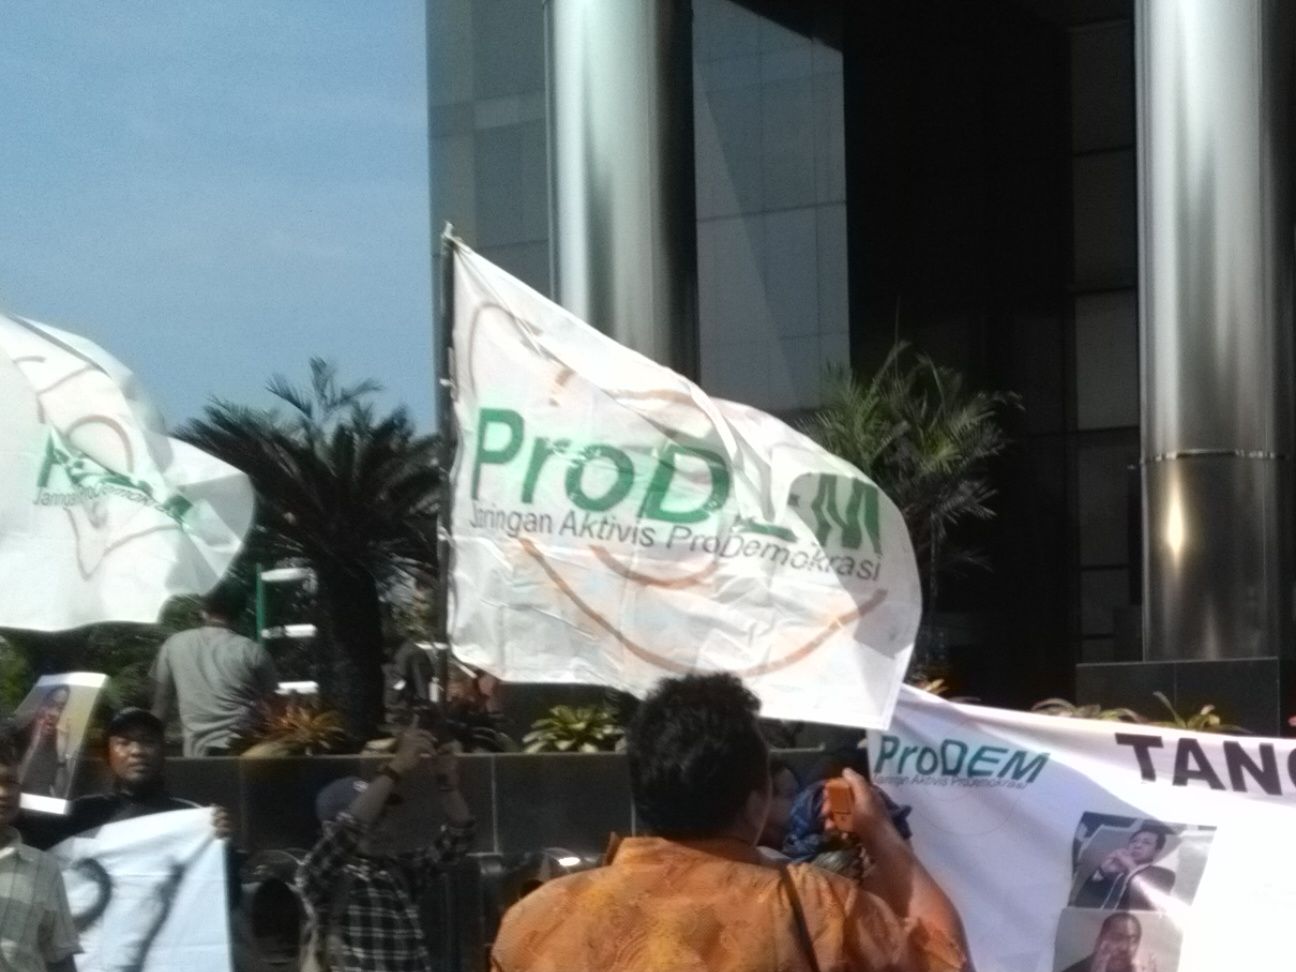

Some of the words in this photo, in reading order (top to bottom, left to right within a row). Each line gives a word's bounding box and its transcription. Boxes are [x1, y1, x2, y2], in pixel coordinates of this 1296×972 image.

[470, 407, 882, 554] ProDM
[559, 509, 657, 548] Aktivis
[666, 524, 883, 582] ProDemokrasi
[873, 734, 1051, 784] ProDEM
